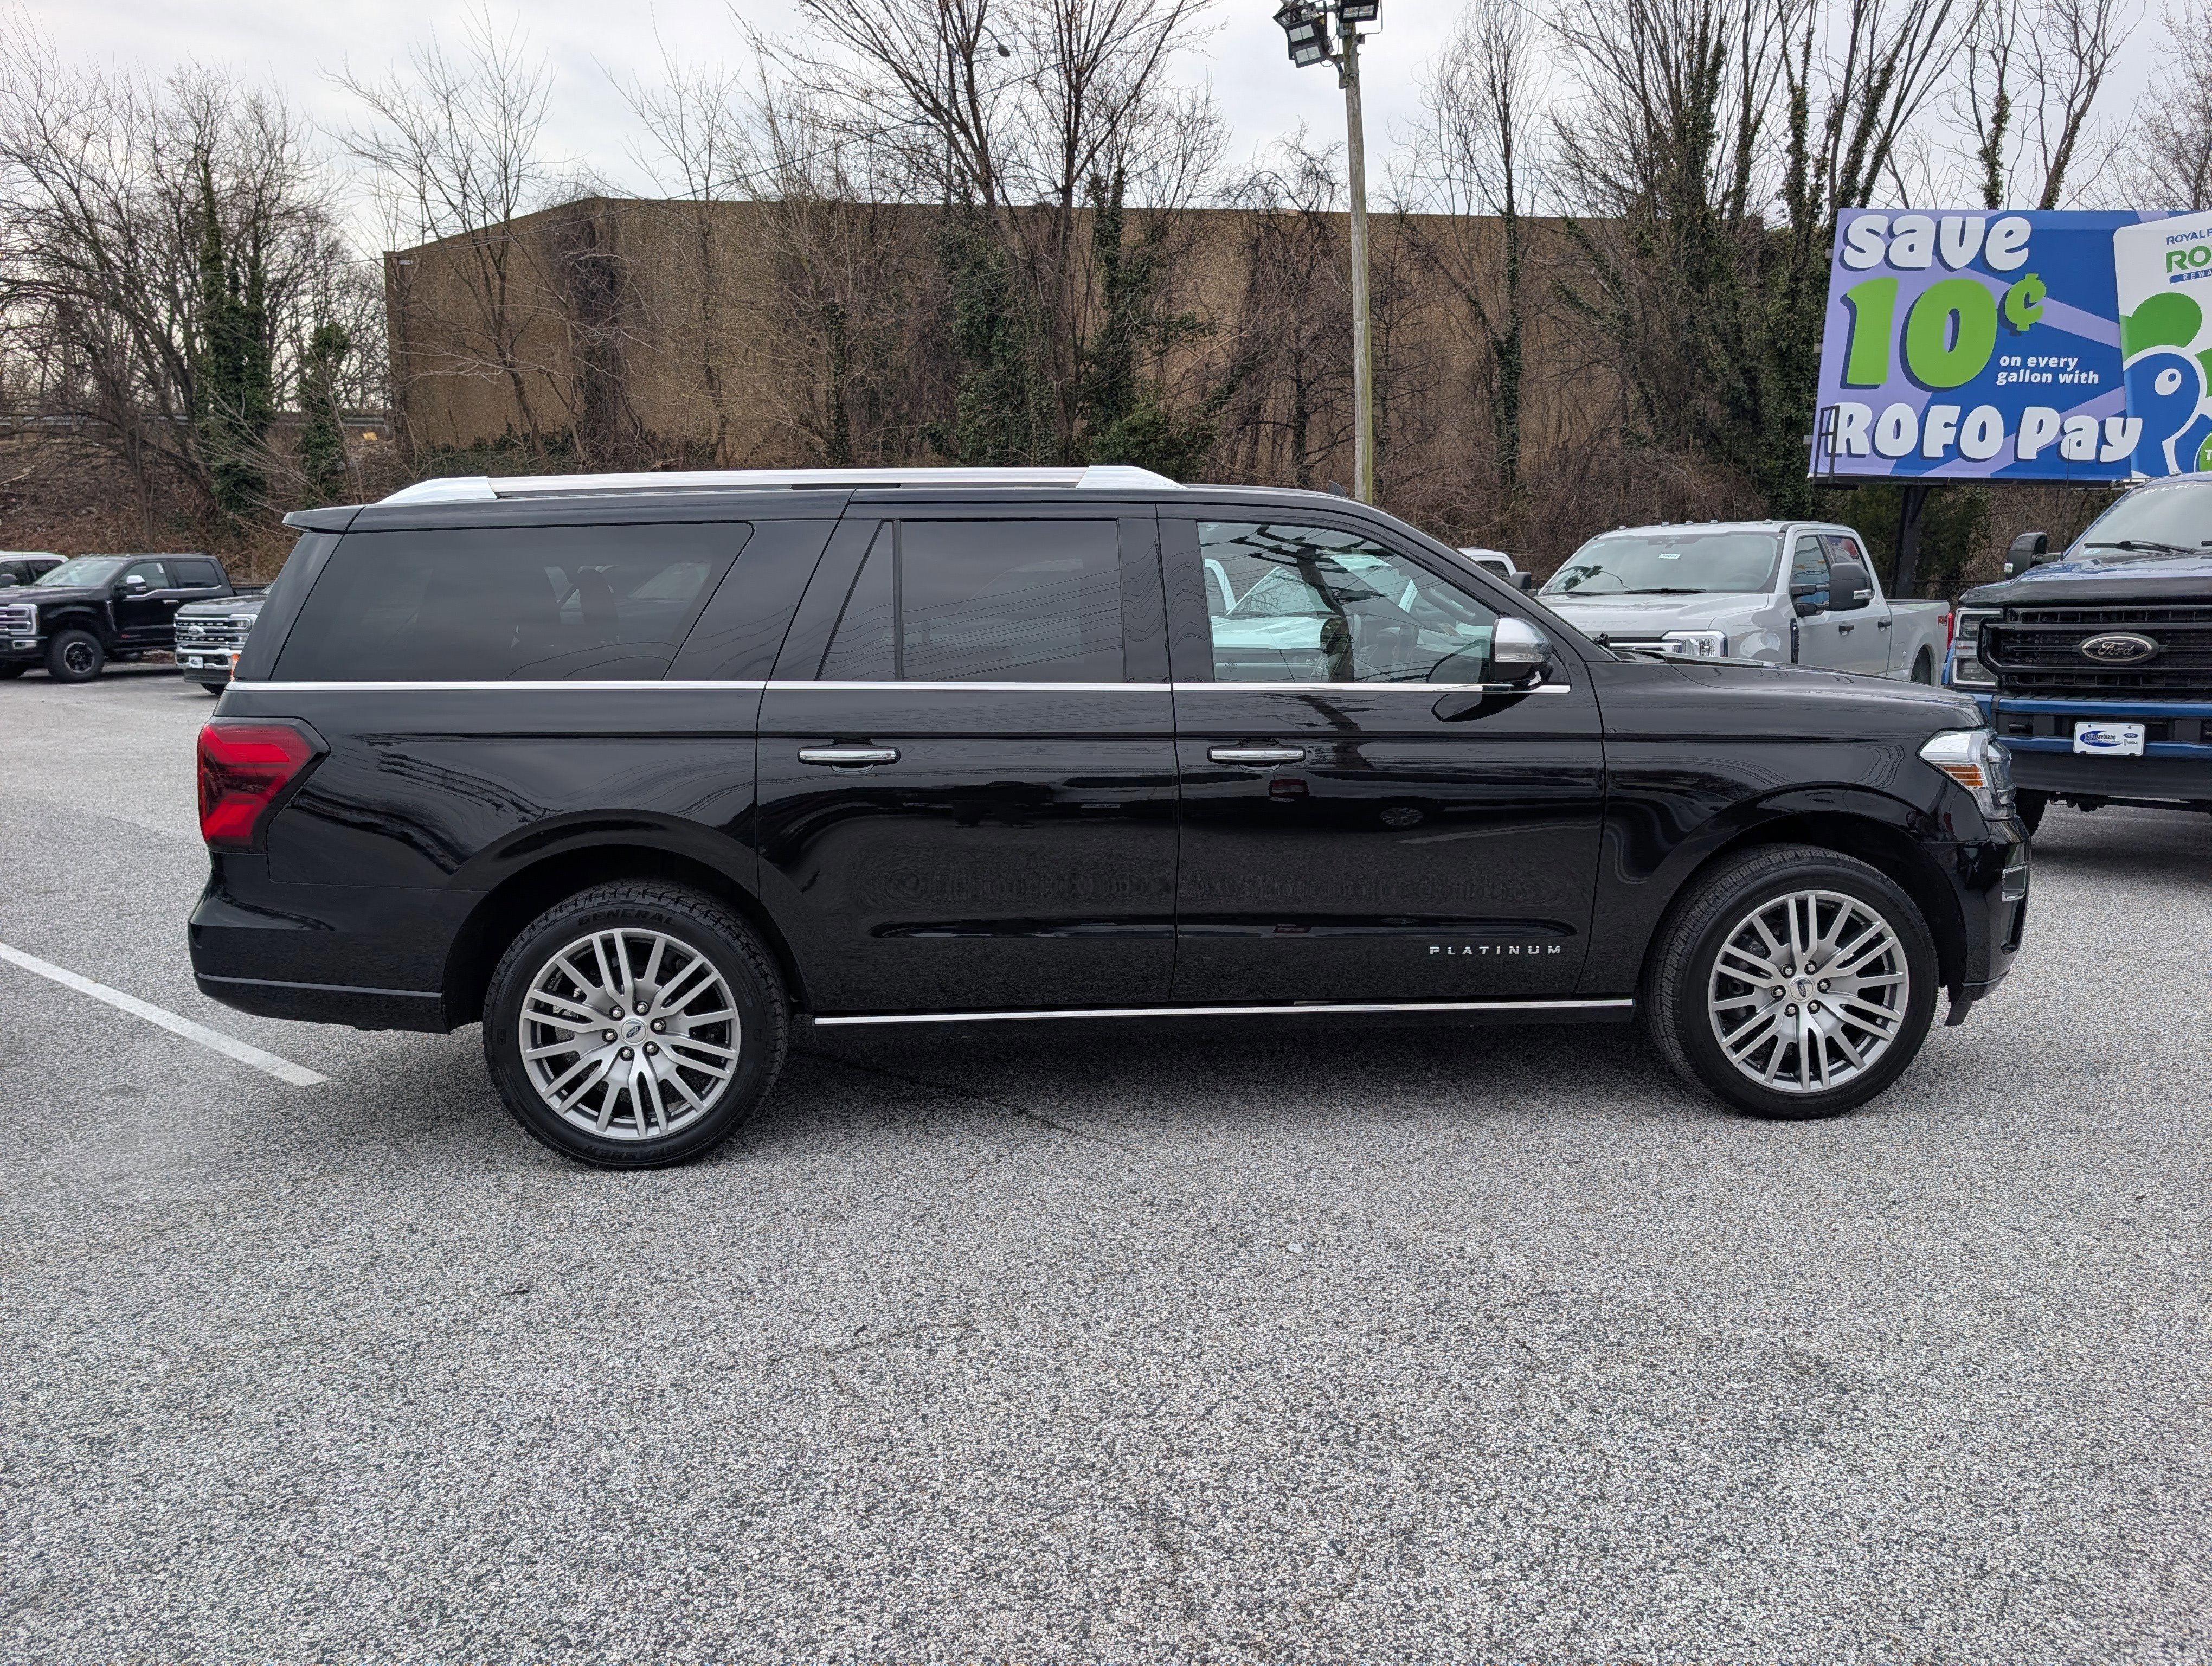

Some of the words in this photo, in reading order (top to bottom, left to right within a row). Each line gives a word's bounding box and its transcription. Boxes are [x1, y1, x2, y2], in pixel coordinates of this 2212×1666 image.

[2166, 230, 2206, 245] ROYAL
[1999, 356, 2021, 367] on
[2027, 356, 2079, 371] every
[1996, 369, 2052, 386] gallon
[2058, 370, 2099, 385] with
[1827, 402, 2004, 459] ROFO
[2017, 406, 2143, 462] Pay
[2097, 641, 2136, 656] Ford
[578, 909, 676, 926] GENERAL
[1429, 946, 1560, 955] PLATINUM
